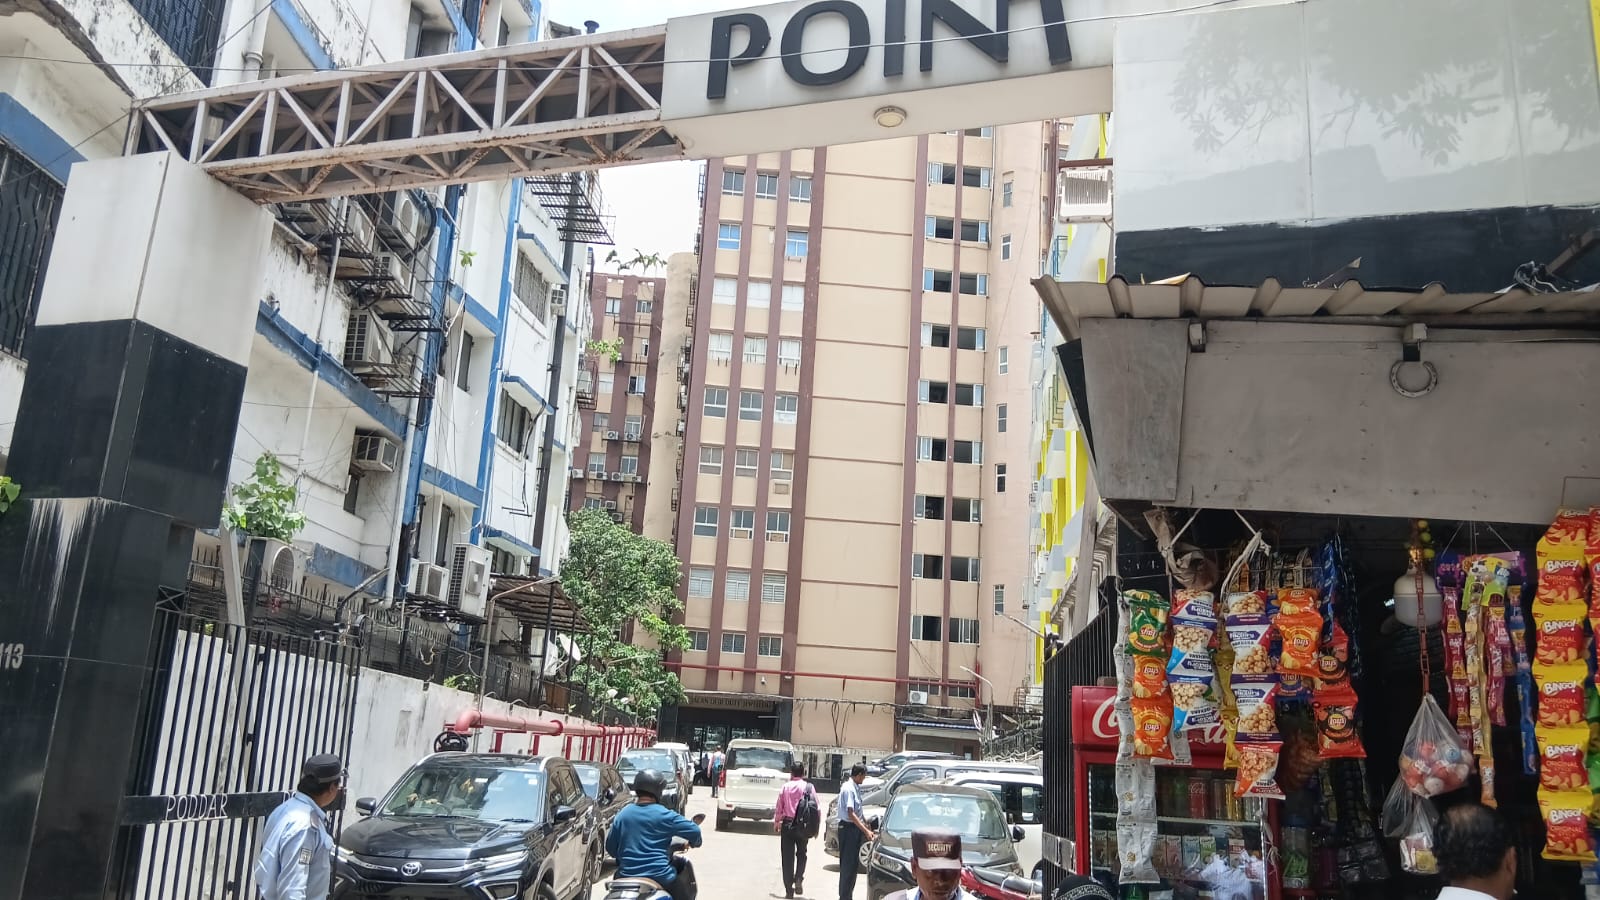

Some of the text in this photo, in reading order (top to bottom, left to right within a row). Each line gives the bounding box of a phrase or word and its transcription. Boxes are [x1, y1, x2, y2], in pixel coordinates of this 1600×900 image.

[707, 0, 1073, 99] POINT
[1545, 560, 1579, 572] BINGO!
[1543, 619, 1577, 633] BINGO!
[1544, 680, 1577, 695] BINGO!
[1544, 697, 1578, 705] ORIGINAL
[1545, 744, 1578, 758] BINGO!
[165, 793, 228, 822] PODDAR
[1549, 808, 1582, 823] BINGO!
[928, 843, 952, 852] SECURITY
